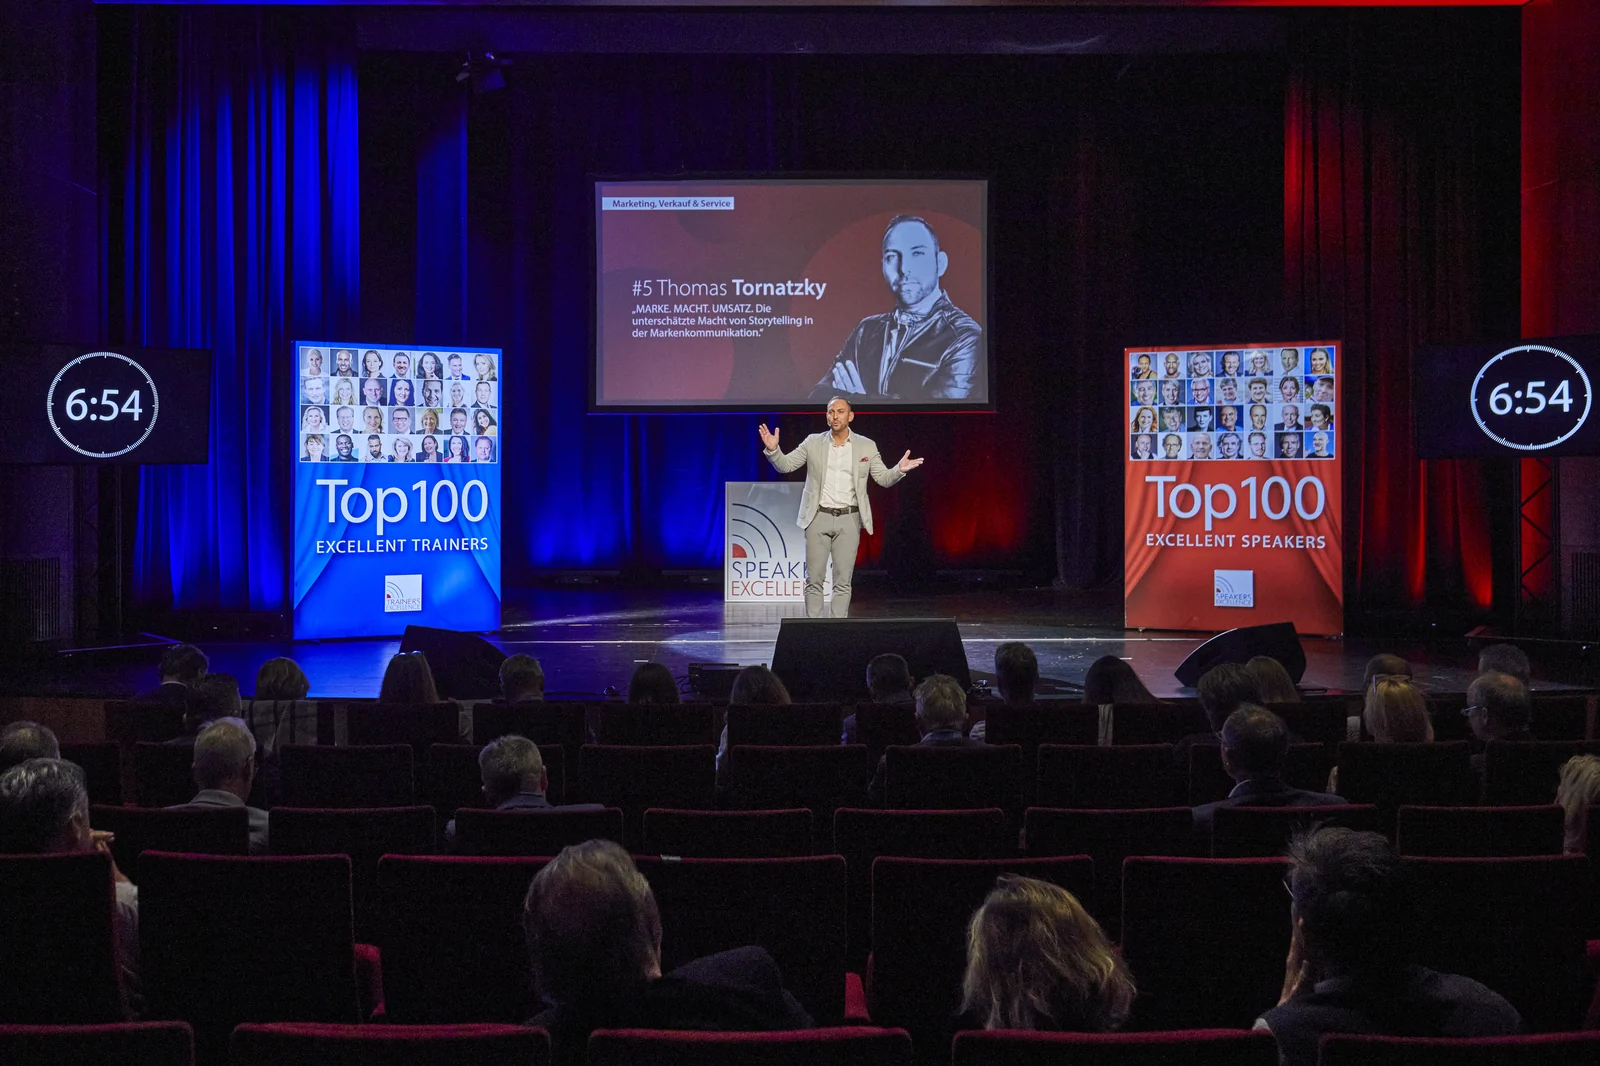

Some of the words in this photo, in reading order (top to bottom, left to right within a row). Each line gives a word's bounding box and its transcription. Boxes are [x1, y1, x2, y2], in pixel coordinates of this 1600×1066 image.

[612, 199, 657, 209] Marketing,
[659, 199, 691, 207] Verkauf
[701, 199, 731, 207] Service
[632, 279, 652, 296] #5
[656, 278, 727, 296] Thomas
[732, 278, 827, 300] Tornatzky
[673, 304, 710, 313] MACHT.
[712, 304, 753, 313] UMSATZ.
[756, 303, 771, 313] Die
[632, 316, 695, 325] unterschätzte
[698, 316, 727, 325] Macht
[748, 315, 802, 327] Storytelling
[804, 315, 813, 325] in
[632, 328, 648, 337] der
[65, 388, 143, 421] 6:54
[1489, 379, 1573, 416] 6:54
[316, 539, 407, 554] EXCELLENT
[411, 537, 489, 551] TRAINERS
[1146, 533, 1236, 547] EXCELLENT
[1241, 534, 1326, 549] SPEAKERS
[732, 560, 833, 579] SPEAK
[386, 597, 421, 605] TRAINERS
[1215, 593, 1252, 601] SPEAKERS
